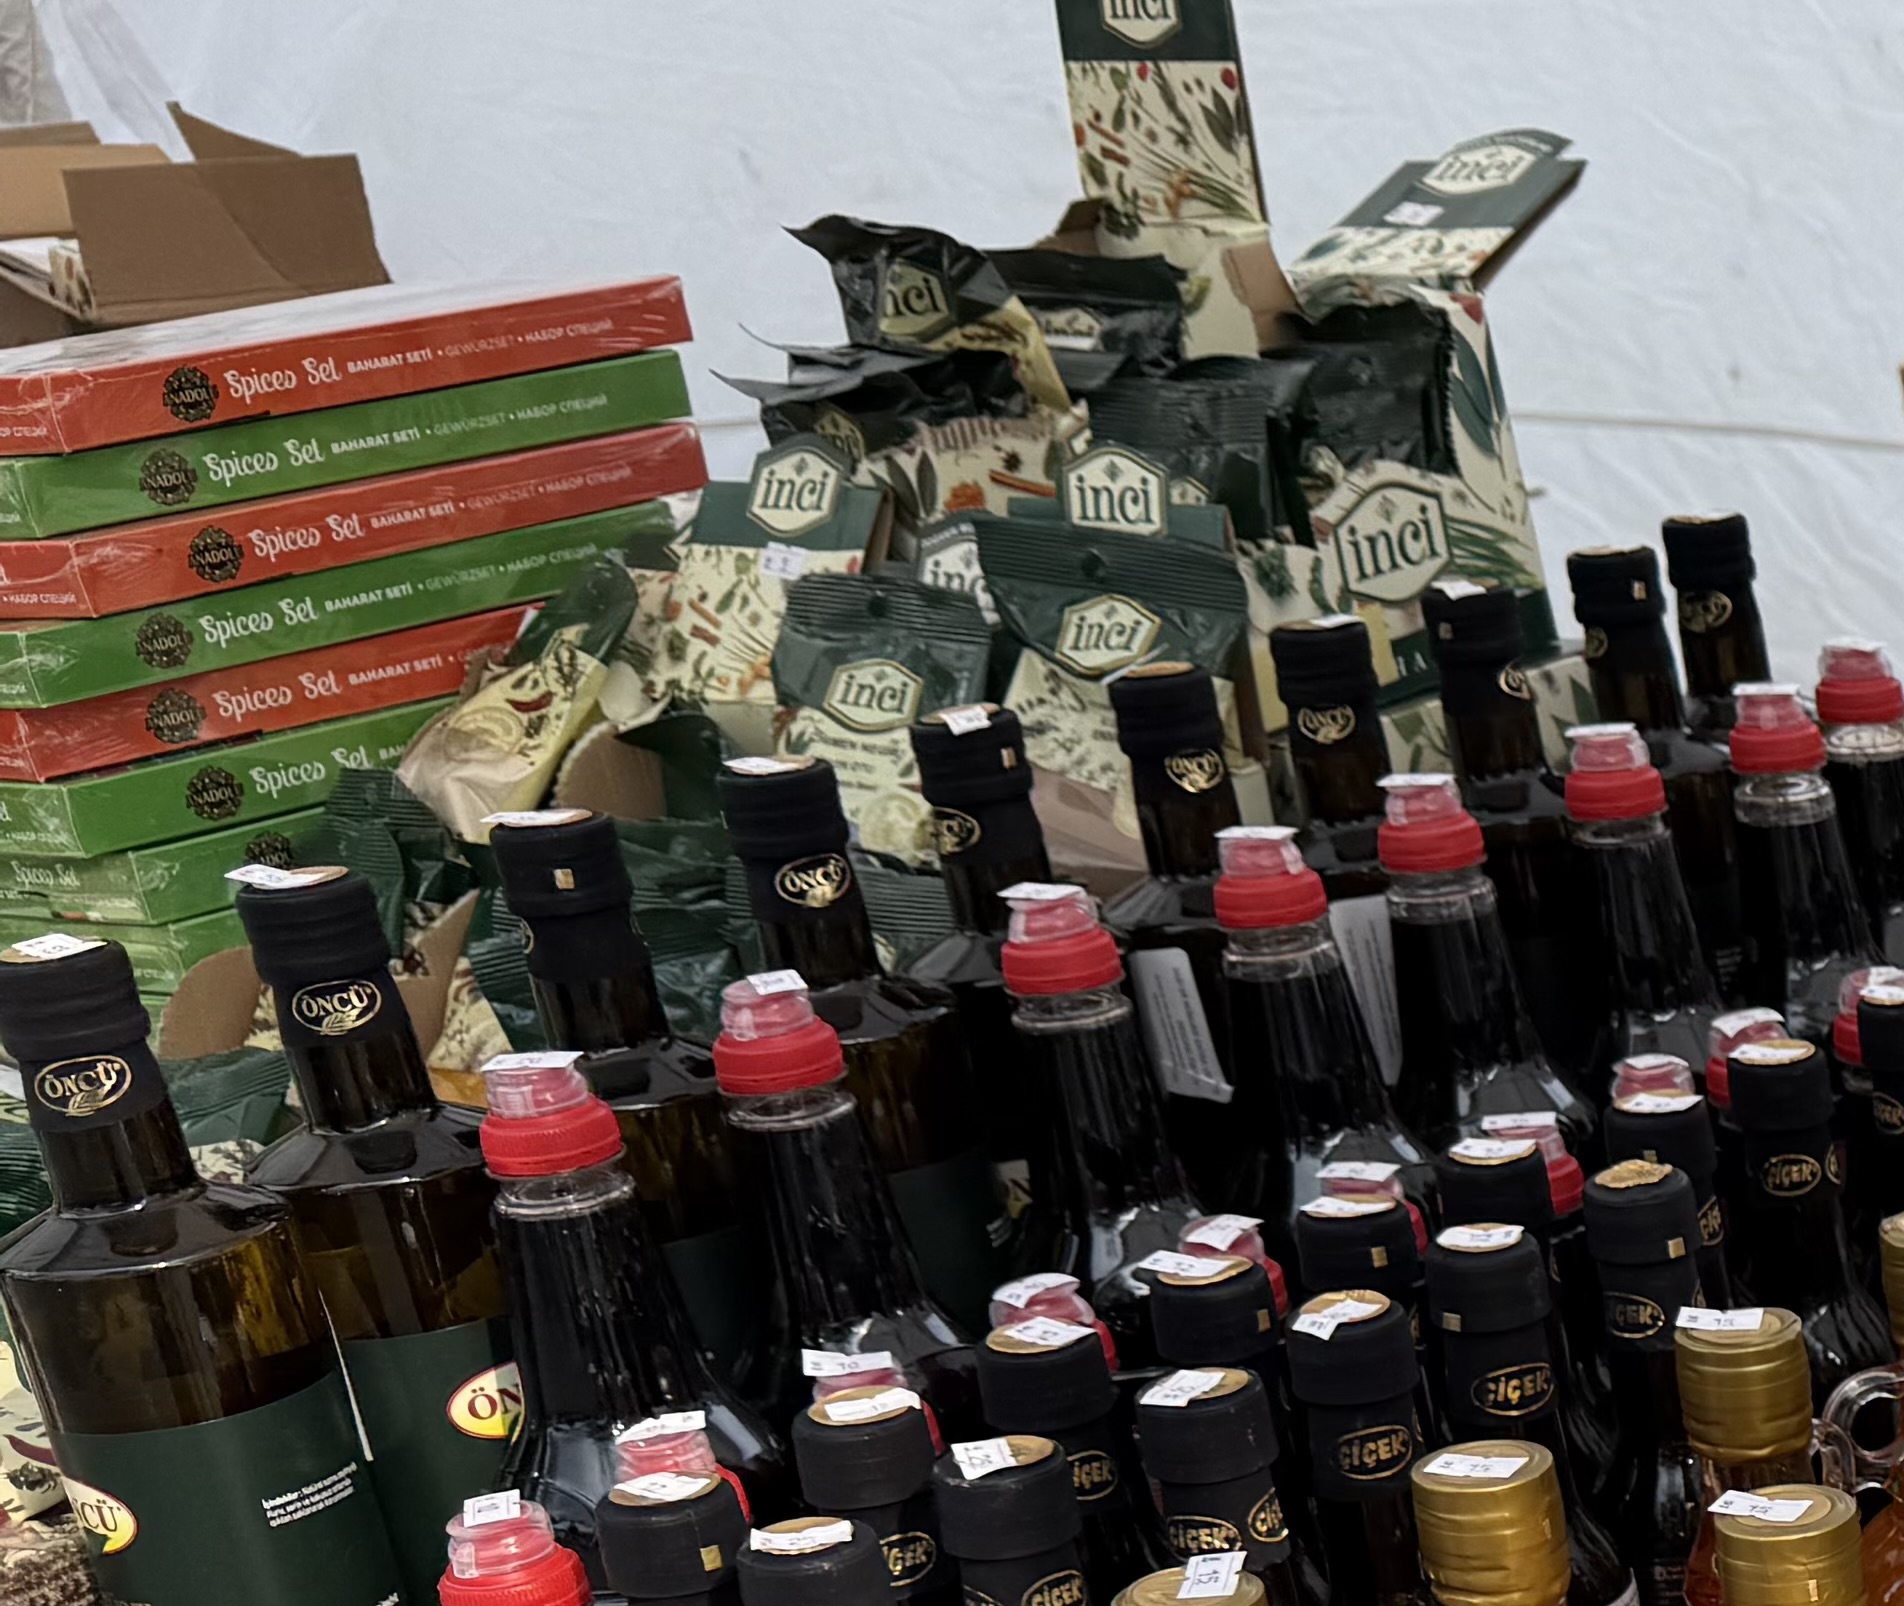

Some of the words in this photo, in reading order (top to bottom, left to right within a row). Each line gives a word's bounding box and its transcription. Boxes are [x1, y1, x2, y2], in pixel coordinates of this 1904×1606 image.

[222, 363, 298, 406] Spices
[347, 353, 404, 374] BAHARAT
[202, 447, 279, 487] Spices
[330, 432, 390, 455] BAHARAT
[761, 472, 831, 512] inci
[1076, 476, 1164, 525] inci
[249, 524, 321, 562] Spices
[1348, 526, 1439, 581] inci
[199, 609, 273, 648] Spices
[324, 590, 384, 613] BAHARAT
[1067, 621, 1137, 656] inci
[211, 686, 293, 722] Spices
[348, 664, 411, 686] BAHARAT
[839, 677, 908, 711] inci
[249, 760, 326, 798] Spices
[302, 982, 371, 1021] ÖNCÜ
[44, 1060, 118, 1100] ÖNCÜ
[466, 1385, 520, 1420] ÖN
[77, 1499, 121, 1535] CÜ
